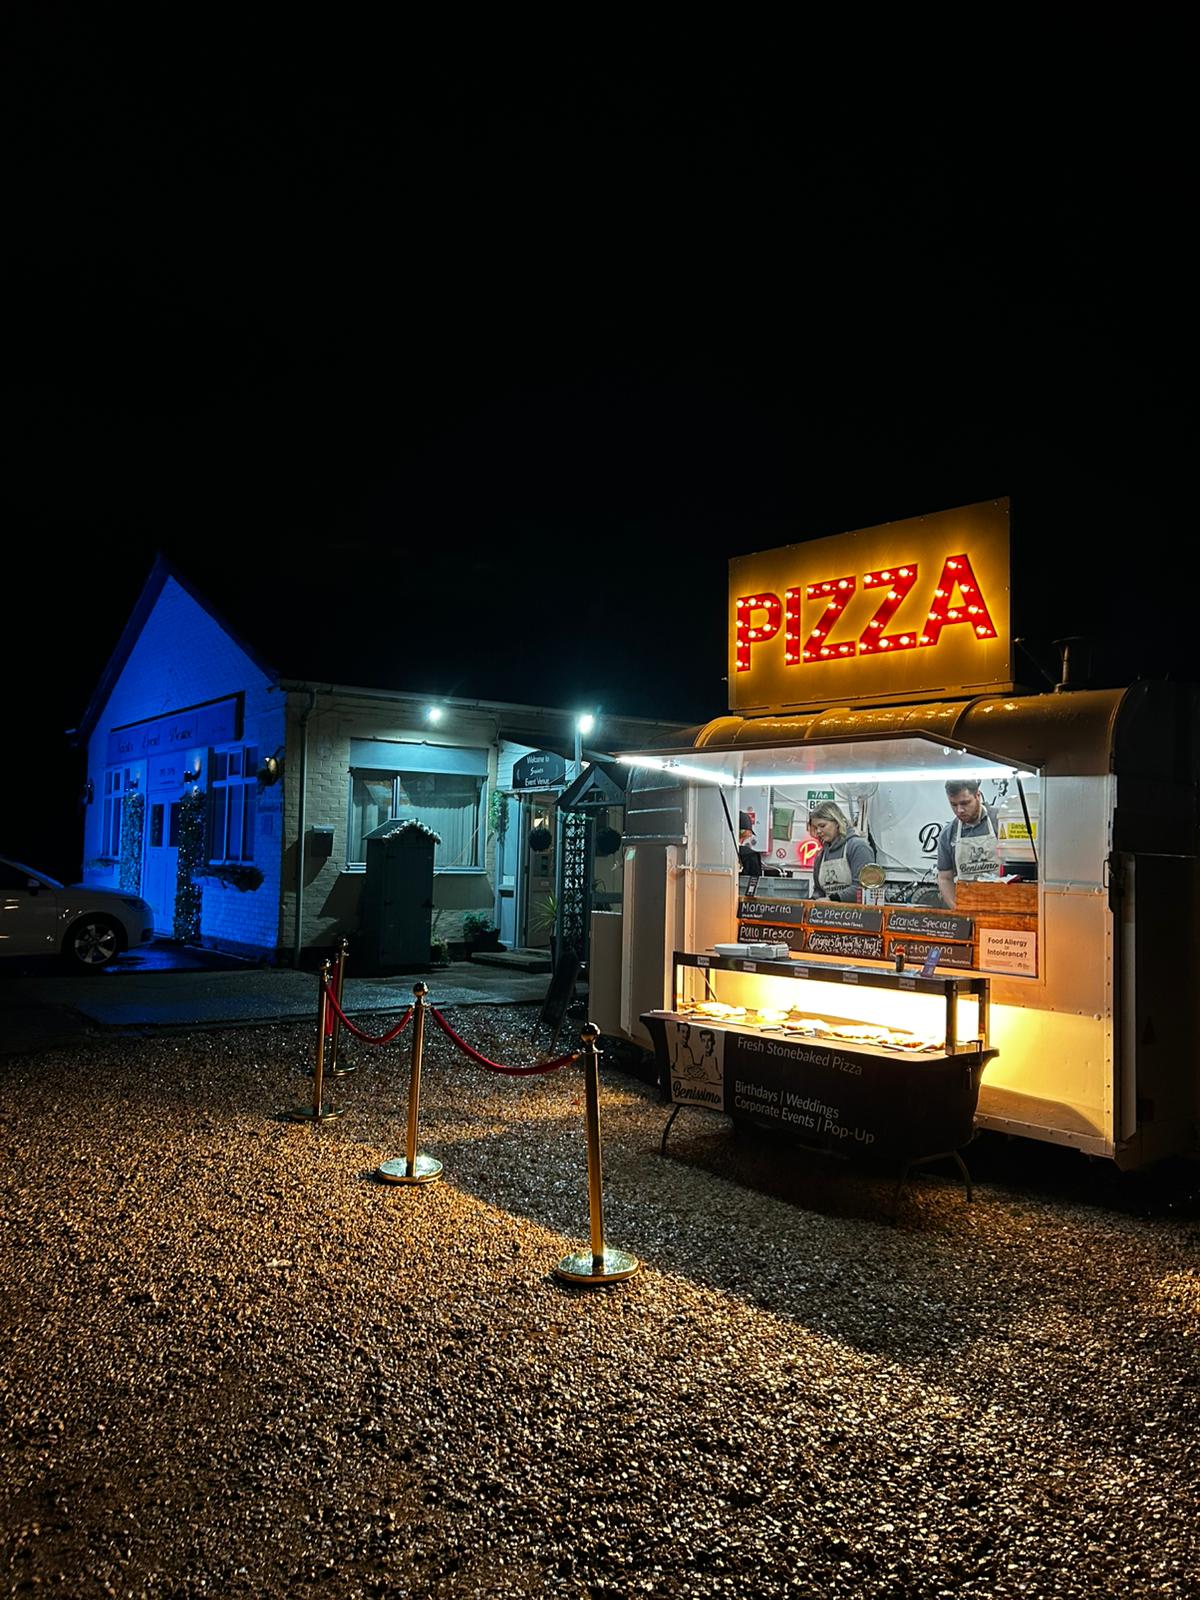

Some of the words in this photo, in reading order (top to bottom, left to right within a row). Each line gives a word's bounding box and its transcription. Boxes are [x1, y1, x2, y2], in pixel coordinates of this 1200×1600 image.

[737, 553, 998, 673] PIZZA
[526, 755, 544, 764] Welcome
[525, 778, 536, 786] Event
[537, 777, 550, 785] Venue
[741, 903, 792, 914] Margherita
[889, 914, 919, 927] Grande
[921, 917, 958, 930] Speciale
[763, 928, 795, 940] Fresco
[1004, 938, 1028, 947] Allergy
[987, 948, 1028, 958] Intolerance?
[737, 1036, 765, 1053] Fresh
[766, 1042, 830, 1067] Stonebaked
[832, 1056, 863, 1076] Pizza
[735, 1080, 778, 1102] Birthdays
[786, 1093, 839, 1119] Weddings
[734, 1096, 780, 1117] Corporate
[781, 1108, 815, 1129] Events
[824, 1119, 875, 1144] Pop-Up
